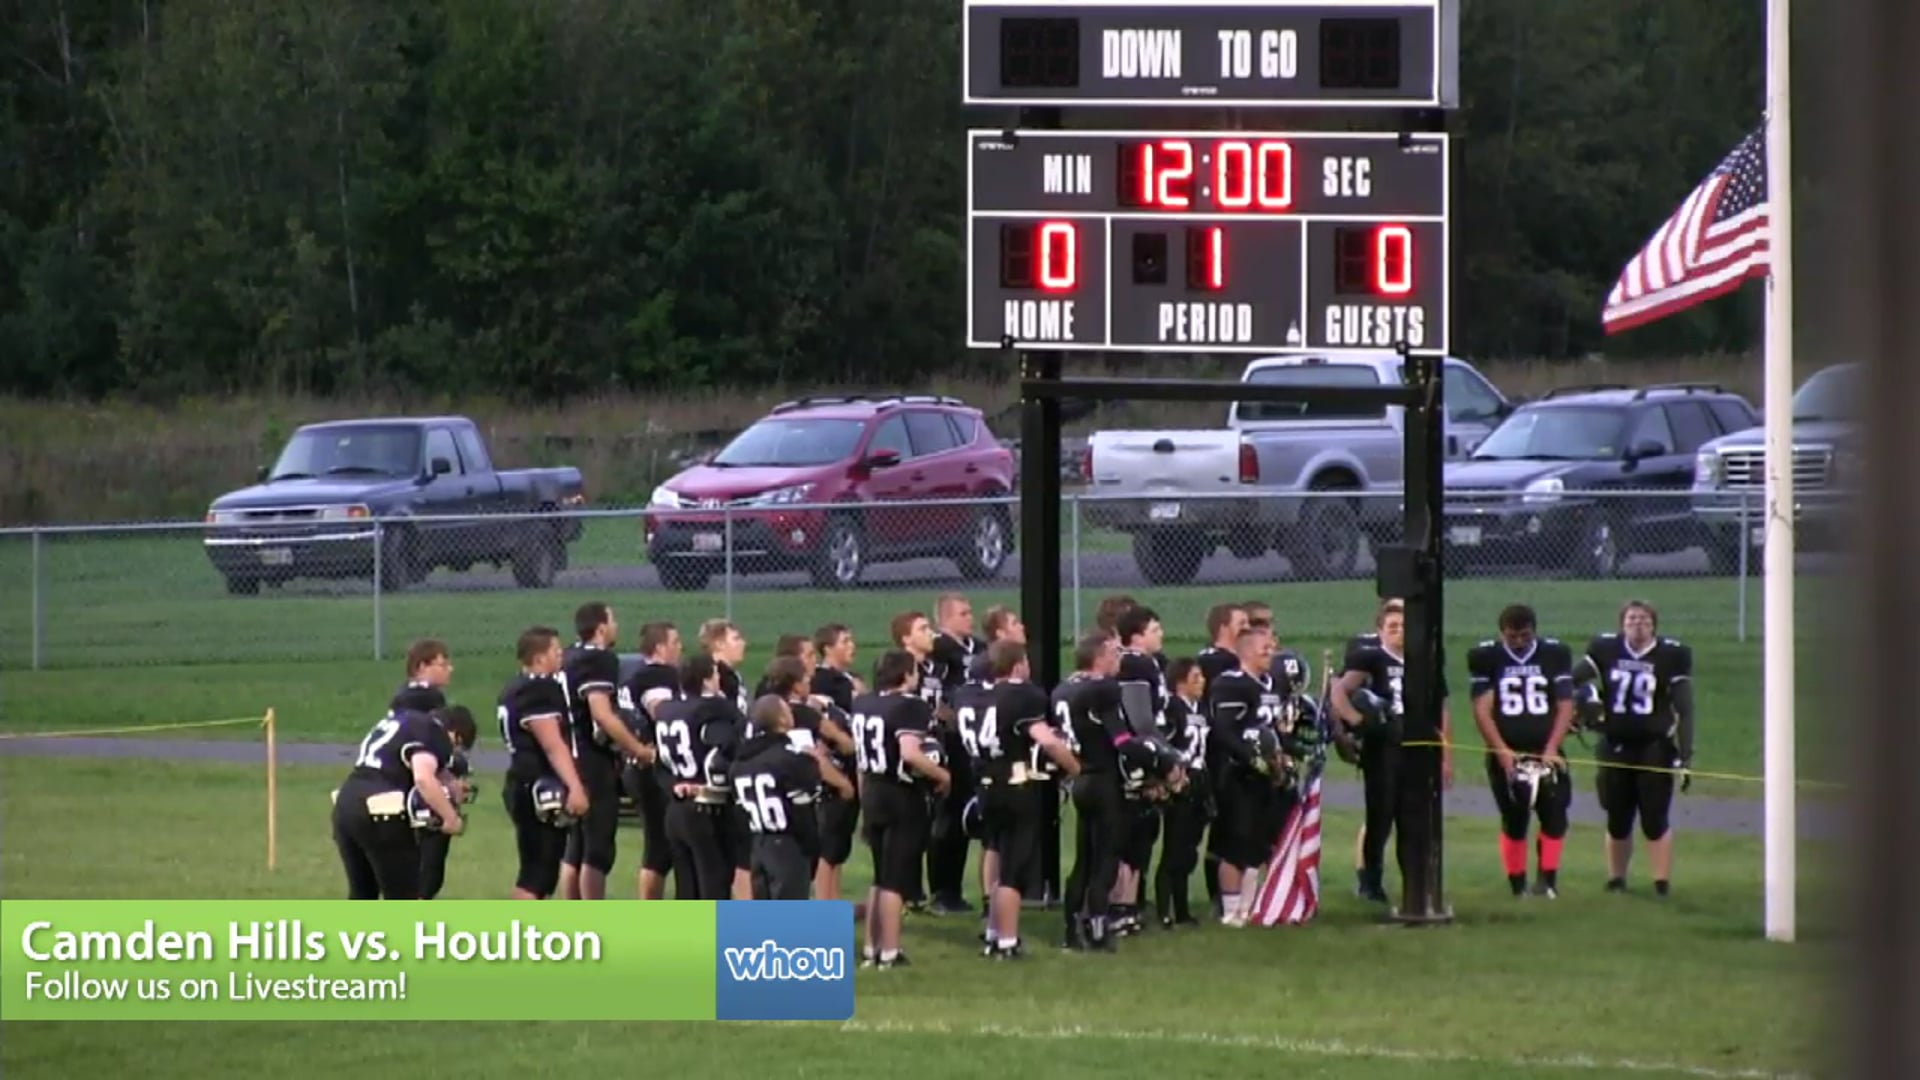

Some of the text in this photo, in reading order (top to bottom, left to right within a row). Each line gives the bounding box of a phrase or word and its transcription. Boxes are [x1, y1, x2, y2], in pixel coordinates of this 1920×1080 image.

[1102, 29, 1182, 79] DOWN
[1217, 29, 1298, 79] TO GO
[1043, 154, 1092, 194] MIN
[1142, 141, 1293, 208] 12:00
[1322, 157, 1371, 198] SEC
[1040, 222, 1076, 289] 0
[1211, 227, 1223, 288] 1
[1377, 226, 1412, 293] 0
[1004, 300, 1075, 341] HOME
[1158, 302, 1253, 342] PERIOD
[1325, 305, 1425, 347] GUESTS
[1500, 675, 1549, 715] 66
[1610, 669, 1657, 714] 79
[655, 719, 698, 778] 63
[957, 706, 1004, 758] 64
[734, 773, 788, 833] 56
